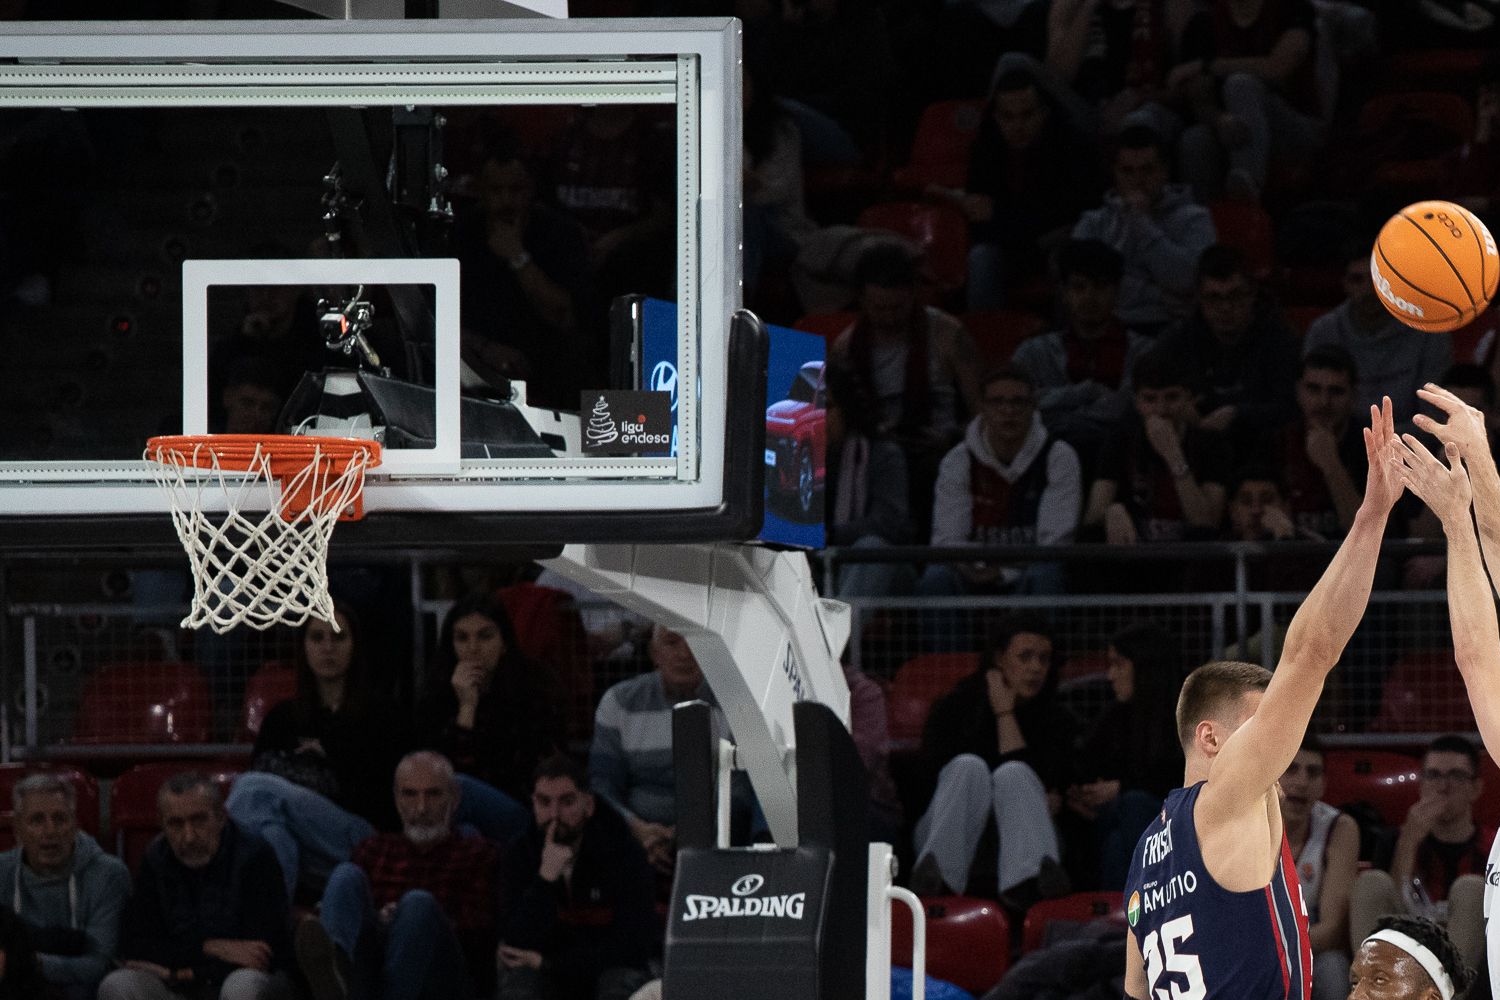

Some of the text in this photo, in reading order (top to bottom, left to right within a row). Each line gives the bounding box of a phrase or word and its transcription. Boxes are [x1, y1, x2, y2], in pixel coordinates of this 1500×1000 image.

[621, 420, 644, 434] liga
[621, 431, 670, 444] endesa
[1143, 870, 1197, 914] AMUTIO
[683, 892, 805, 921] SPALDING
